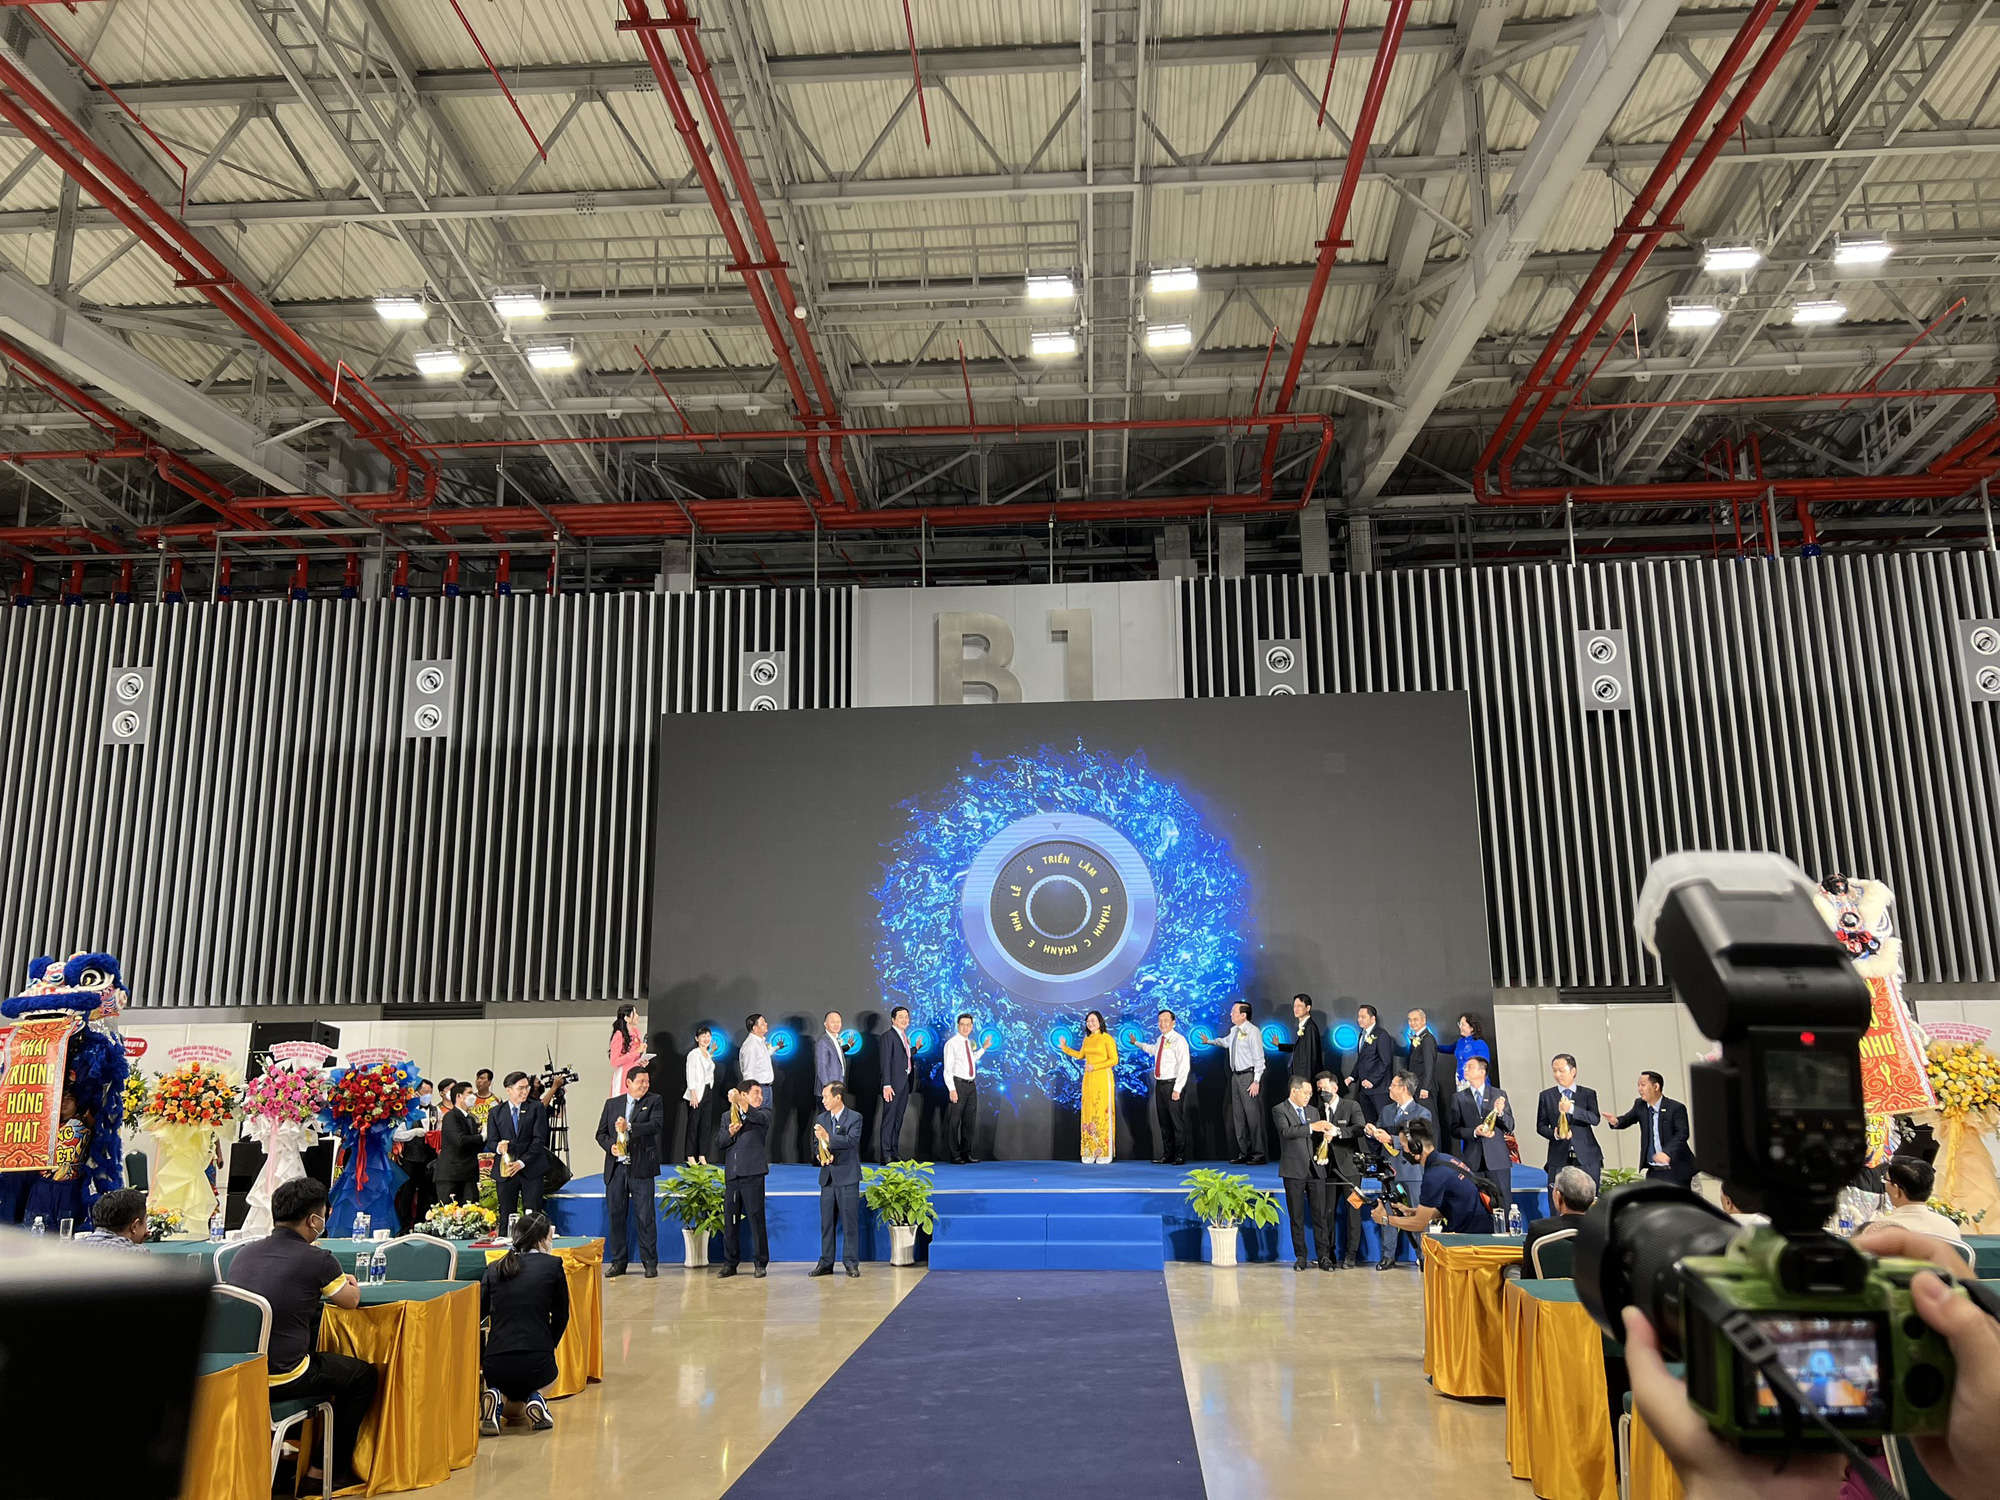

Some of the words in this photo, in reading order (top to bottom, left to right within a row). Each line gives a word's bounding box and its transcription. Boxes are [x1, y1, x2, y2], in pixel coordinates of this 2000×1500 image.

[936, 608, 1094, 705] B1
[1026, 865, 1034, 874] S
[1077, 860, 1098, 877] LÃM
[1100, 887, 1109, 895] B
[1092, 904, 1111, 937] THÀNH
[1027, 939, 1036, 948] E
[1043, 944, 1078, 957] KHÁNH
[1083, 939, 1092, 948] C
[20, 1038, 51, 1057] KHAI
[1859, 1032, 1897, 1058] NHƯ
[1879, 1061, 1892, 1086] Ý
[6, 1088, 44, 1115] HỒNG
[3, 1118, 41, 1144] PHÁT
